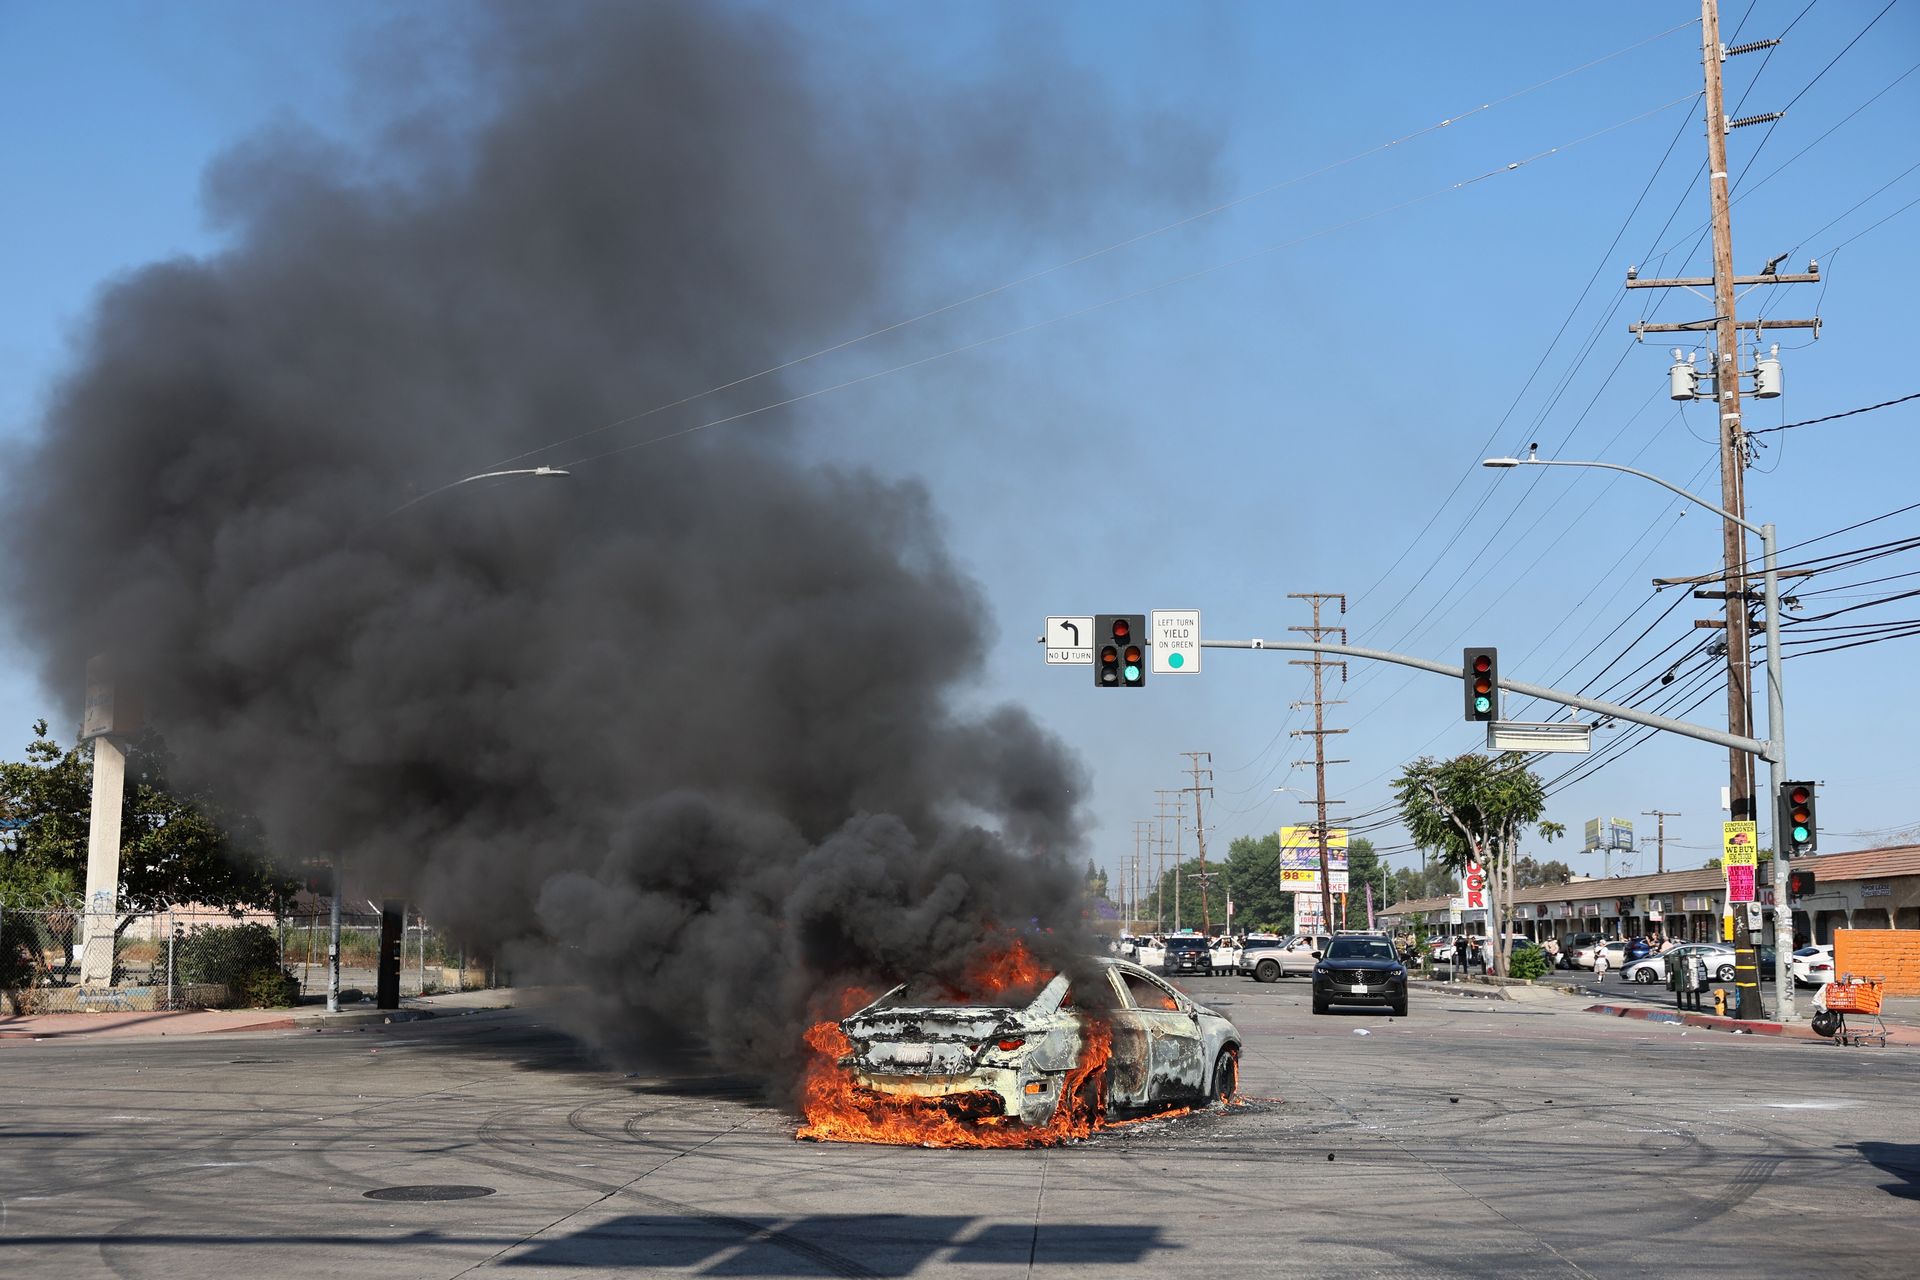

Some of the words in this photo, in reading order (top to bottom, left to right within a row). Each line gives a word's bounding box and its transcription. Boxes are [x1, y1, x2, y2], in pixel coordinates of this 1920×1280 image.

[1157, 619, 1174, 627] LEFT
[1176, 618, 1195, 627] TURN
[1163, 629, 1189, 639] YIELD
[1158, 641, 1169, 649] ON
[1171, 641, 1194, 649] GREEN
[1061, 652, 1069, 660] U
[1072, 652, 1091, 660] TURN
[1316, 883, 1347, 891] MRKET
